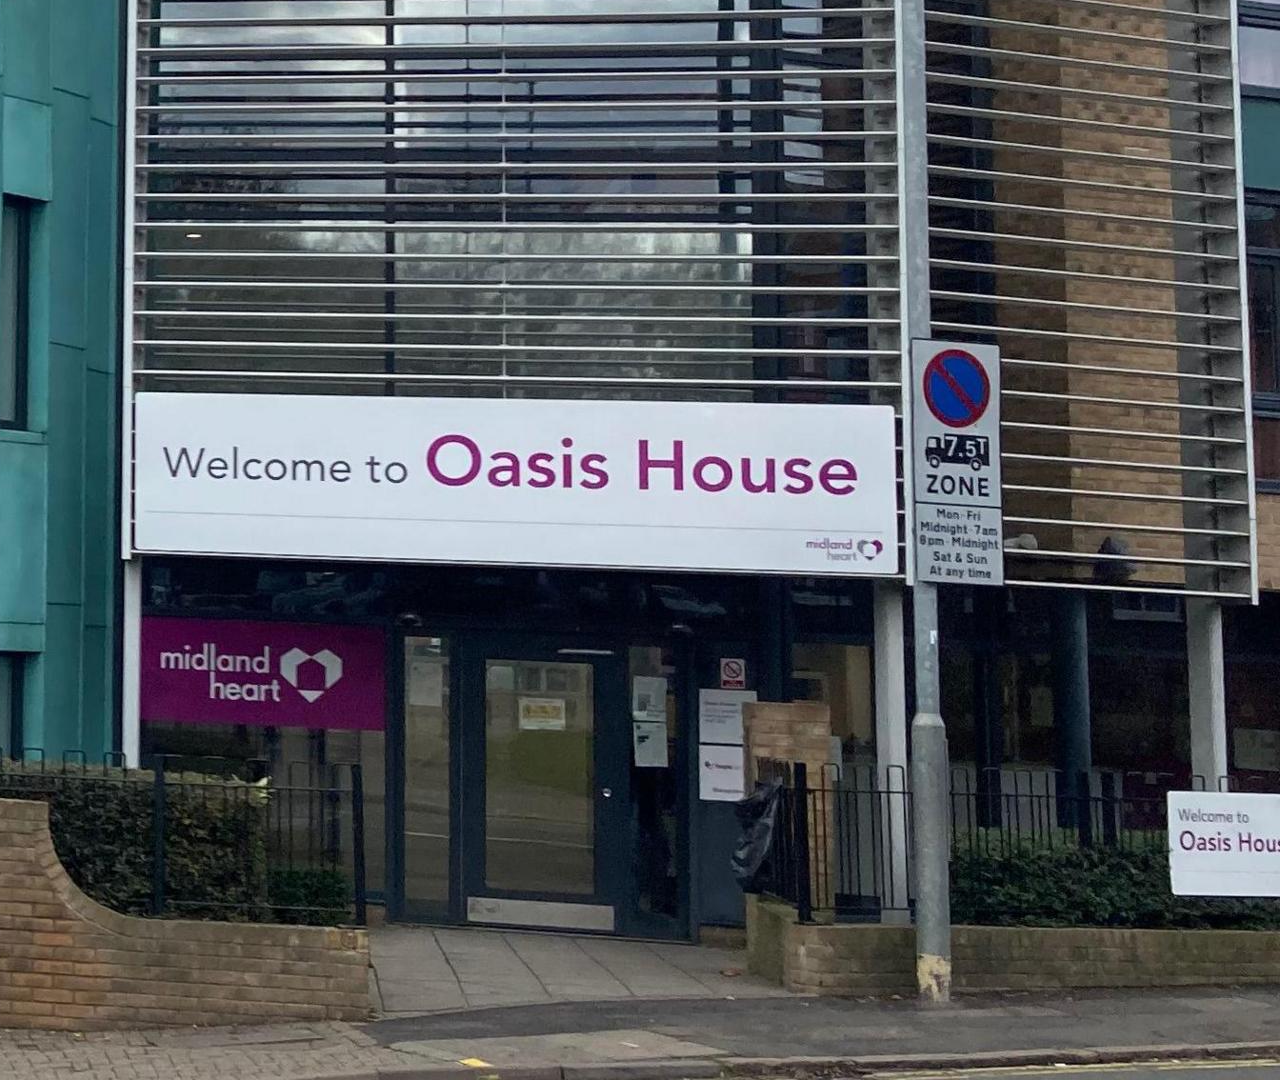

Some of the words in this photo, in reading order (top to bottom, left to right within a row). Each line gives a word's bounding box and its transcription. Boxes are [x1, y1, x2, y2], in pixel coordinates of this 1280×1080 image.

[162, 445, 352, 483] Welcome
[365, 455, 409, 484] to
[426, 433, 609, 490] Oasis
[637, 438, 859, 496] House
[926, 473, 990, 497] ZONE
[936, 508, 959, 519] Mon
[966, 510, 981, 521] Fri
[920, 521, 968, 535] Midnight
[806, 537, 852, 550] midland
[951, 537, 999, 551] Midnight
[827, 549, 858, 561] heart
[933, 551, 951, 563] Sat
[955, 552, 963, 563] &
[966, 553, 988, 565] Sun
[930, 565, 942, 576] At
[945, 569, 964, 579] any
[968, 567, 992, 579] time
[159, 642, 270, 674] midland
[209, 671, 281, 702] heart
[1178, 808, 1233, 823] Welcome
[1237, 811, 1250, 824] to
[1179, 830, 1232, 852] Oasis
